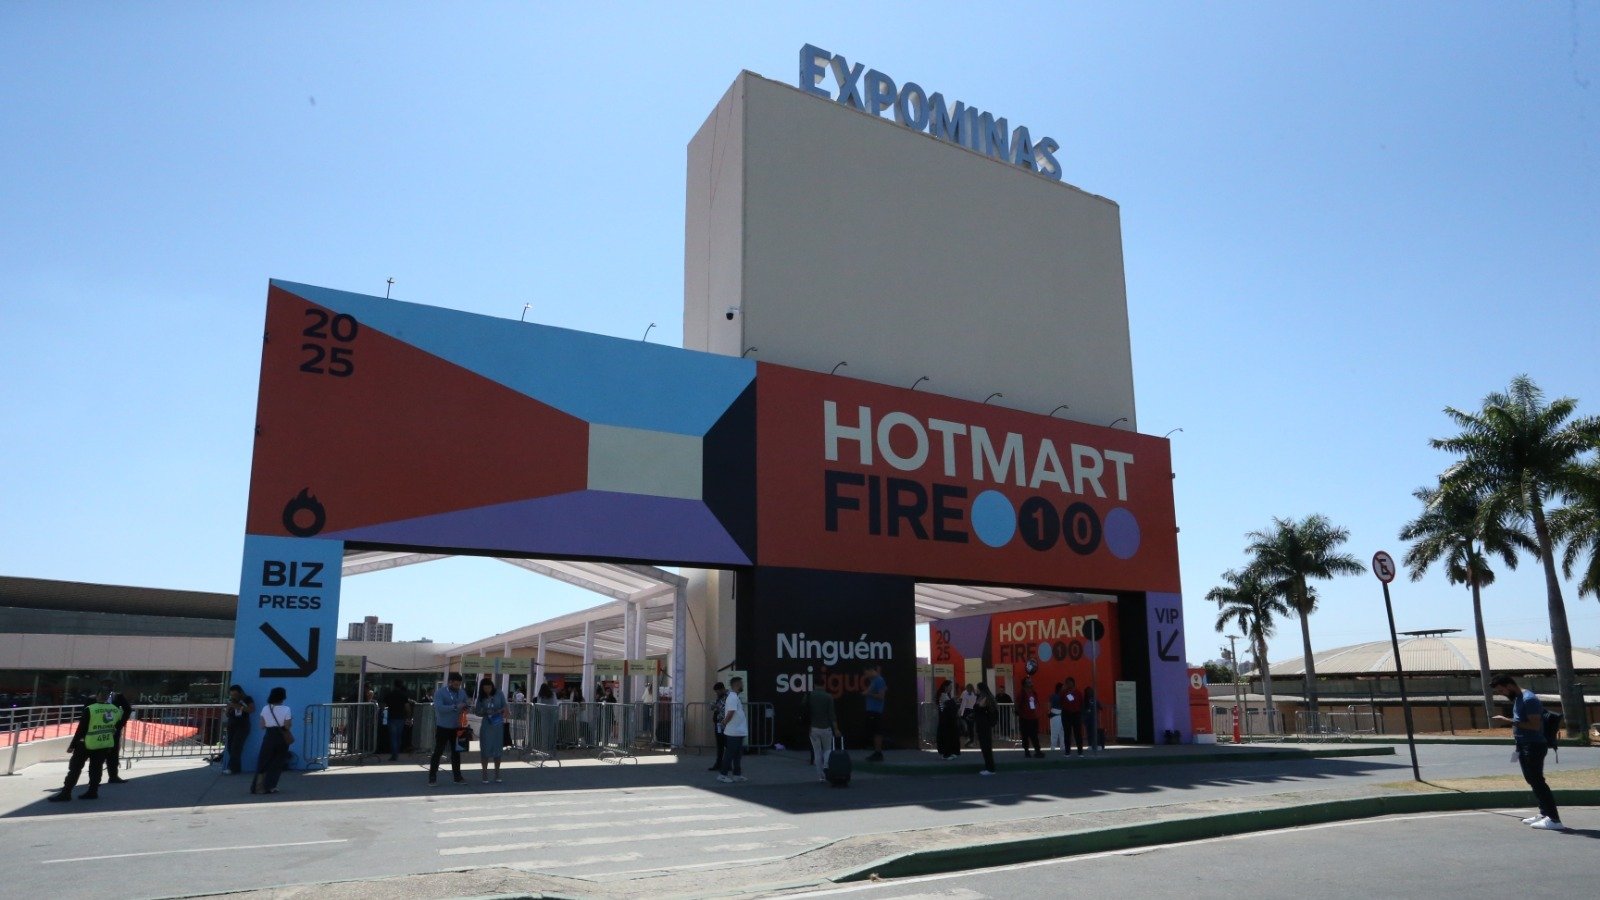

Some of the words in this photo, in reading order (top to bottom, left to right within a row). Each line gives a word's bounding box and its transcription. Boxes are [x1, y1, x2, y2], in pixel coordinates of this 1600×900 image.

[799, 43, 1063, 181] EXPOMINAS
[303, 308, 358, 343] 20
[299, 343, 354, 378] 25
[823, 400, 1135, 501] HOTMART
[825, 469, 969, 544] FIRE
[262, 560, 324, 588] BIZ
[258, 594, 321, 610] PRESS
[1154, 607, 1179, 625] VIP
[776, 632, 893, 666] Ninguém
[936, 629, 951, 645] 20
[936, 645, 951, 662] 25
[776, 665, 814, 693] sai
[819, 664, 883, 699] igua
